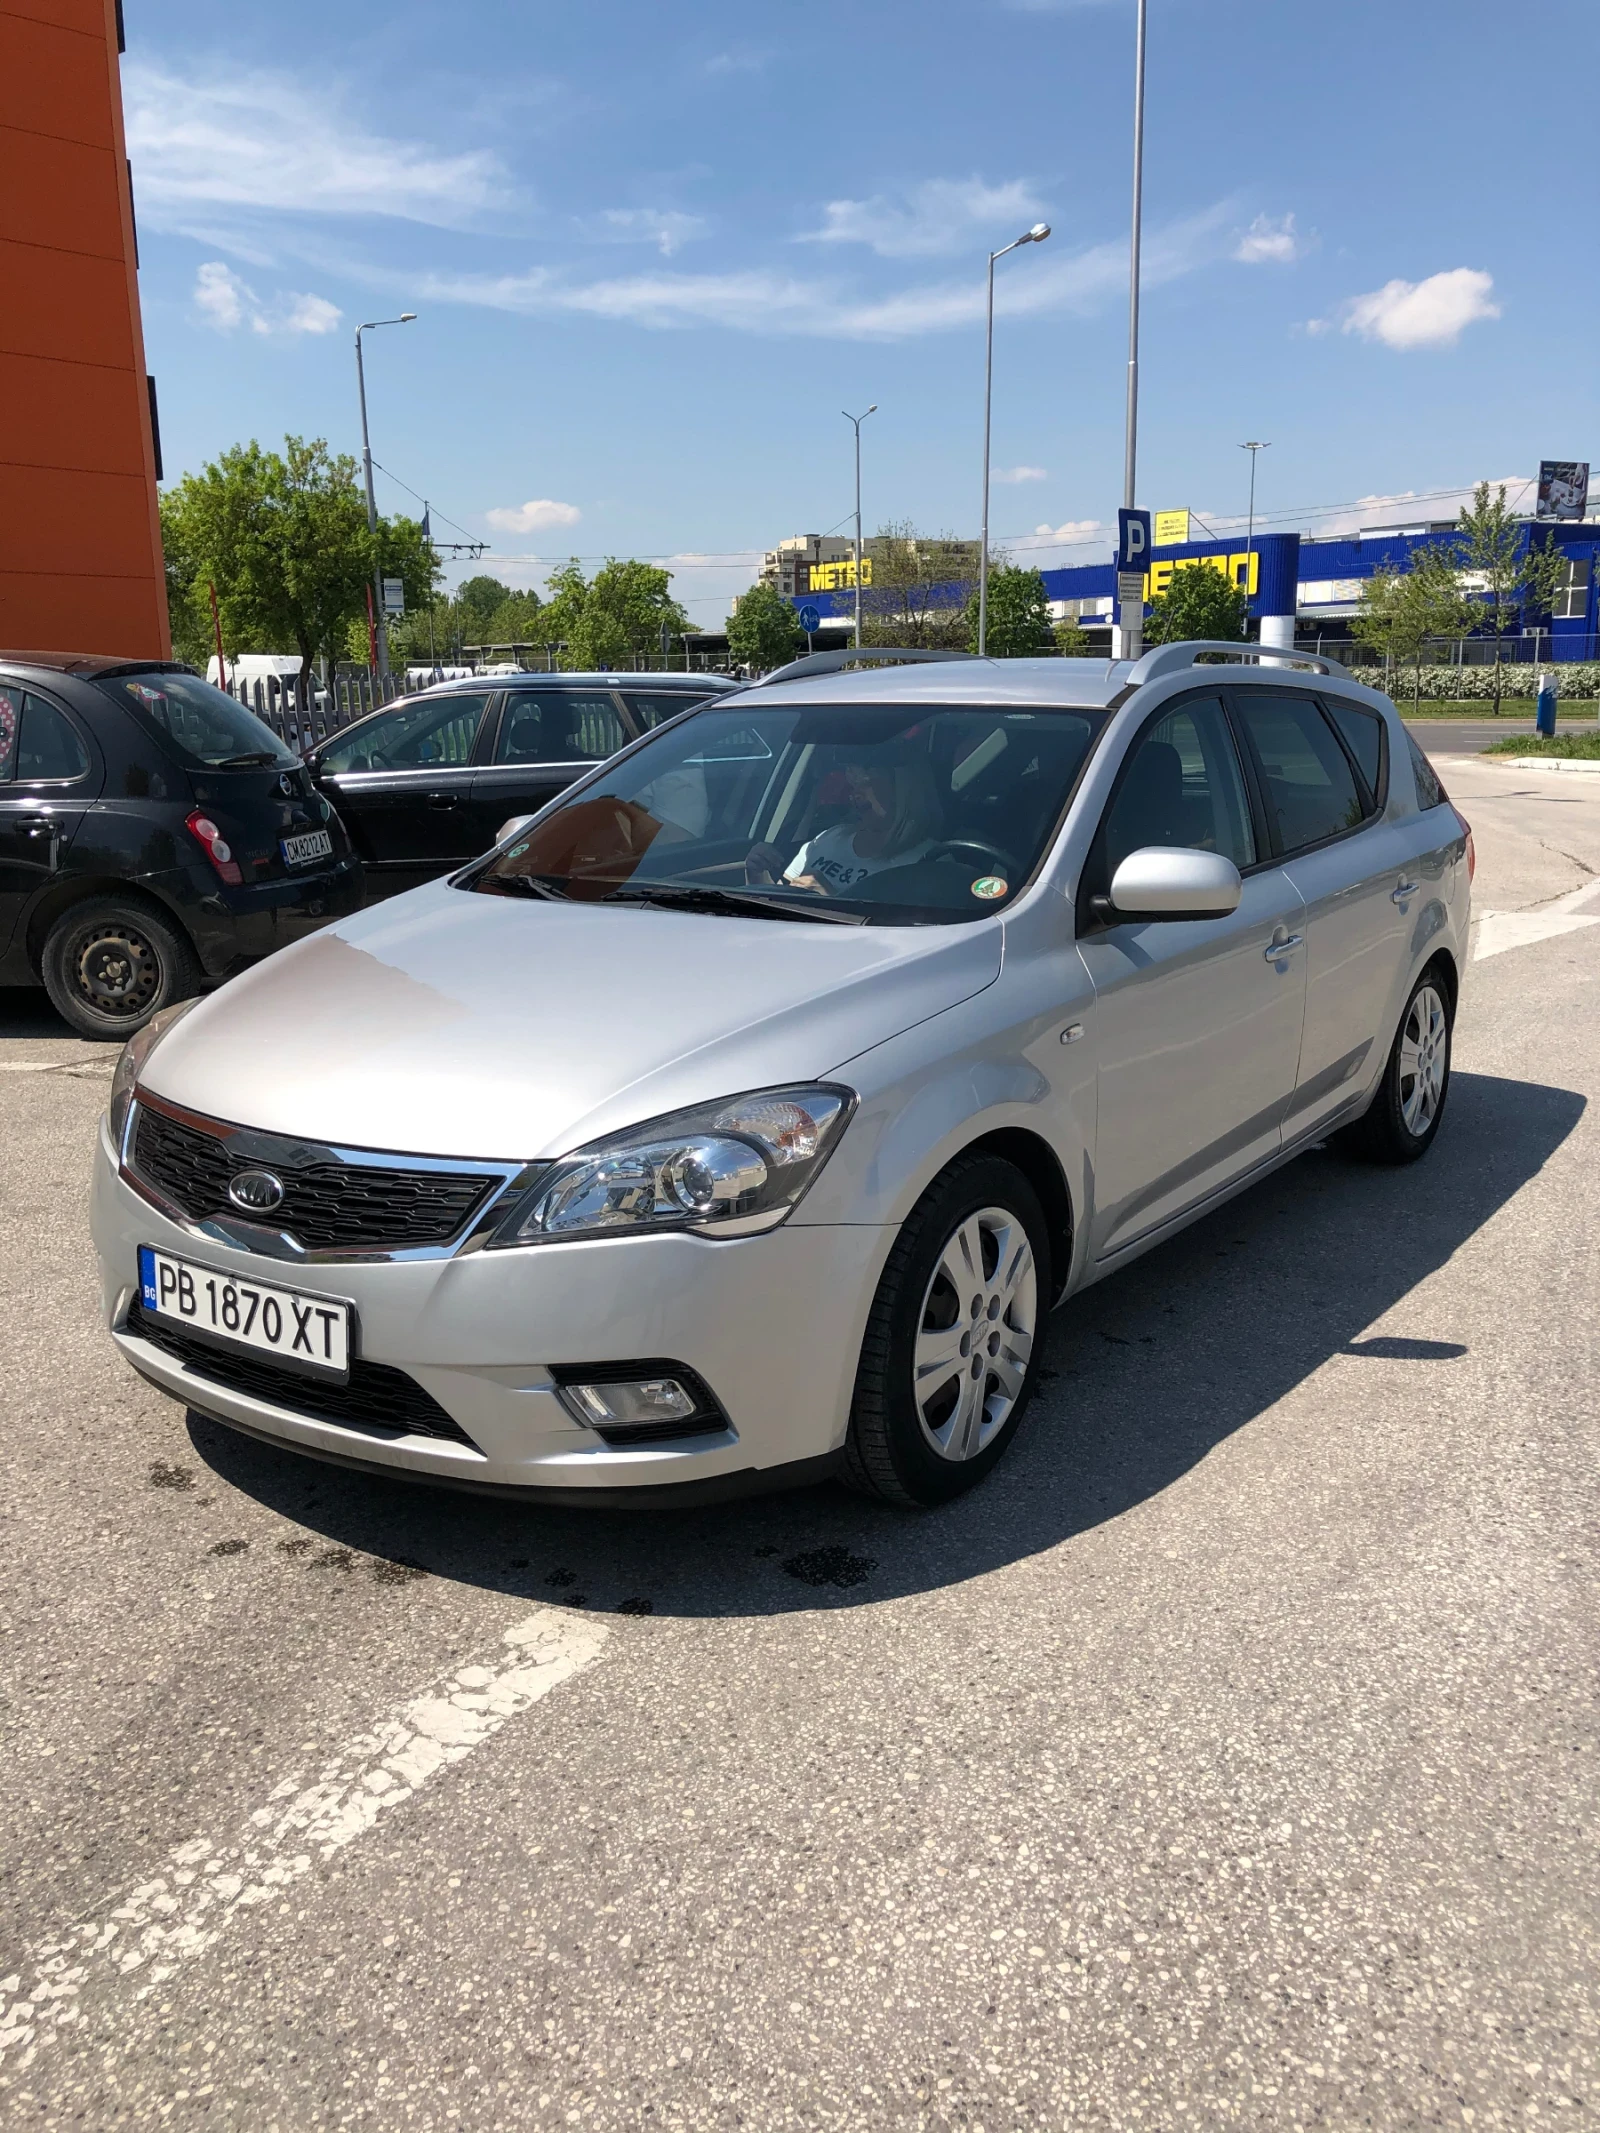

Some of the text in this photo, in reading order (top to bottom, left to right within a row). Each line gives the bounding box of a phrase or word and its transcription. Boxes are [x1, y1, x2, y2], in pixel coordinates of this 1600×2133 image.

[1126, 519, 1145, 563] P
[809, 558, 872, 592] METRO
[144, 1284, 156, 1301] BG
[159, 1261, 340, 1359] PB 1870 XT
